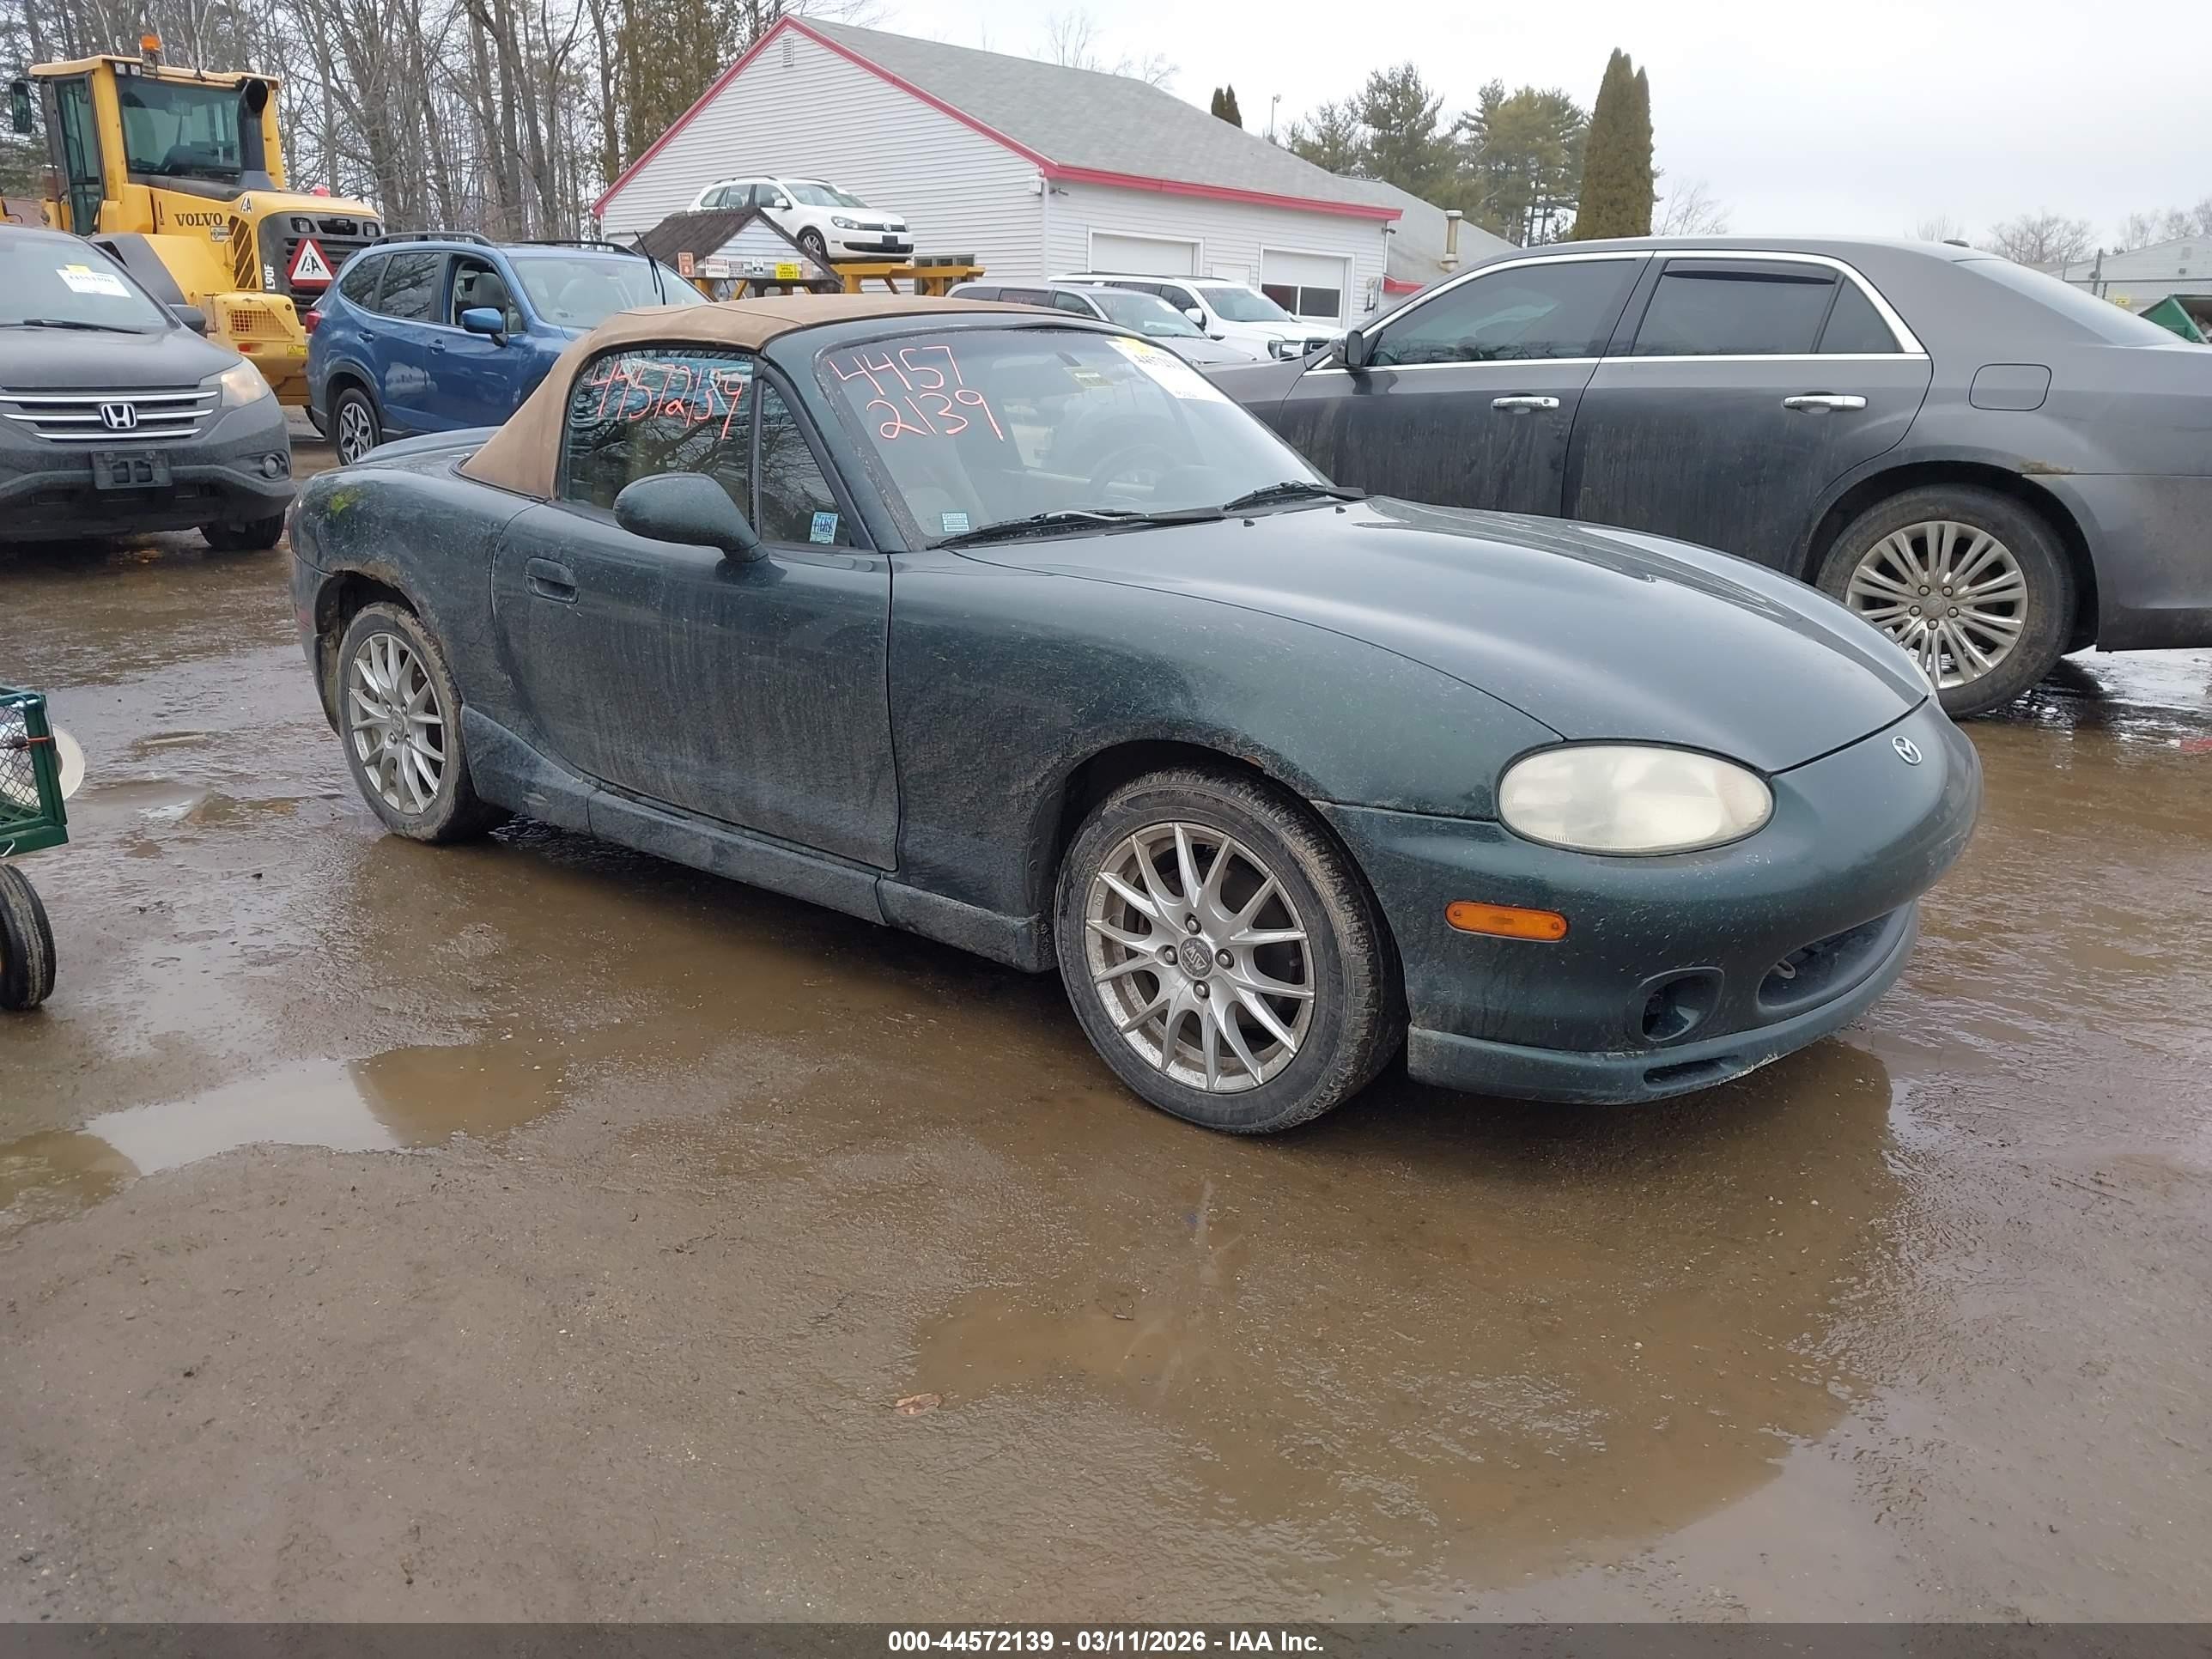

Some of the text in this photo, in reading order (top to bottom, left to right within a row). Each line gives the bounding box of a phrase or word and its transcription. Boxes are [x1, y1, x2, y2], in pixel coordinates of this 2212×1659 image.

[174, 212, 222, 227] VOLVO
[264, 263, 276, 290] L90F
[828, 345, 963, 397] 4457
[866, 388, 1005, 442] 2139
